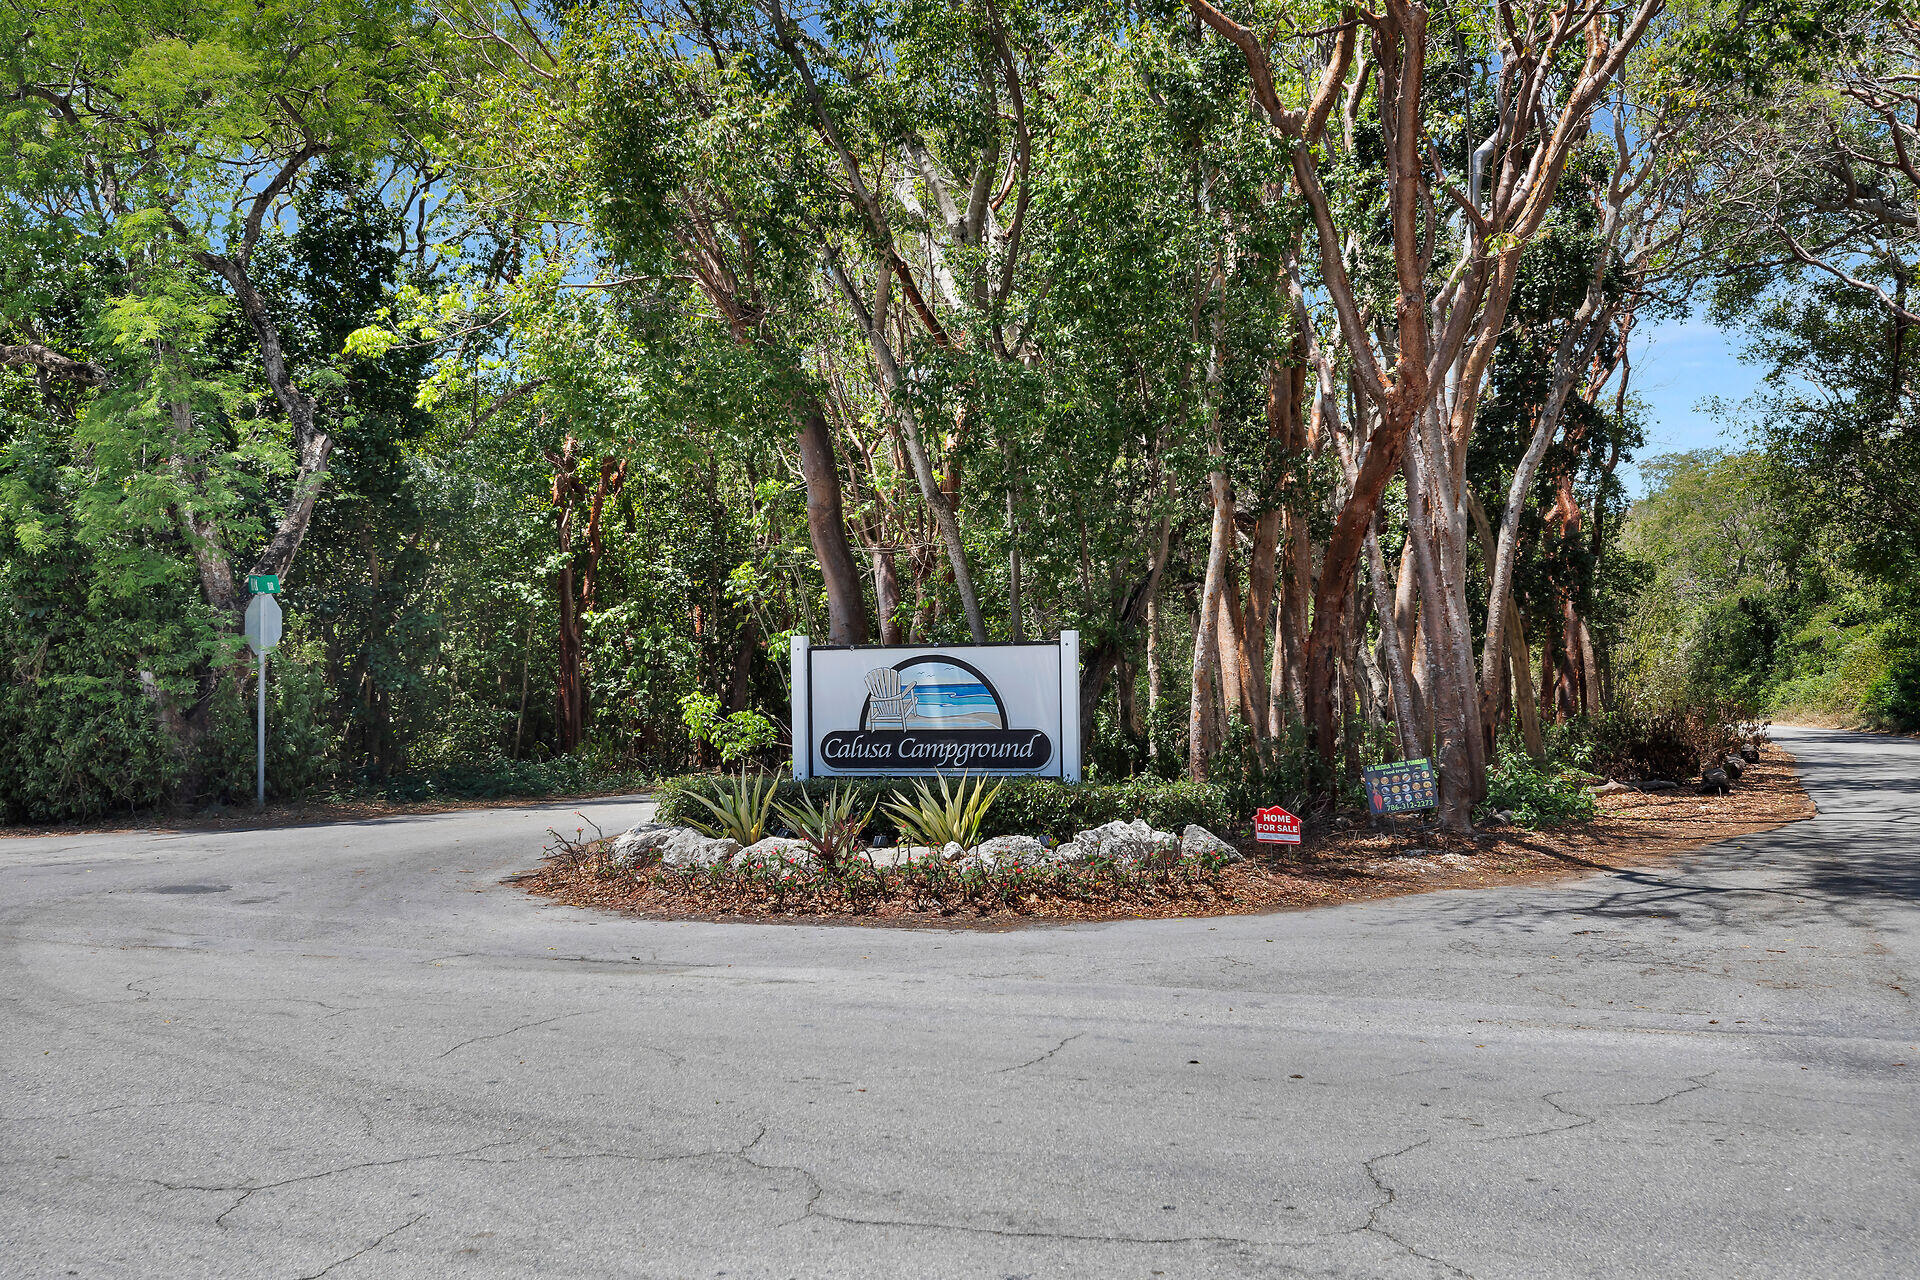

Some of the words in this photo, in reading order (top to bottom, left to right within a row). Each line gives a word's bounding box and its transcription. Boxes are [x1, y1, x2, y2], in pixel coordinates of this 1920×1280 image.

[824, 734, 892, 759] Calusa
[898, 733, 1042, 767] Campground
[1386, 799, 1434, 811] 786-312-2273
[1263, 814, 1291, 823] HOME
[1257, 823, 1275, 832] FOR
[1277, 824, 1298, 833] SALE
